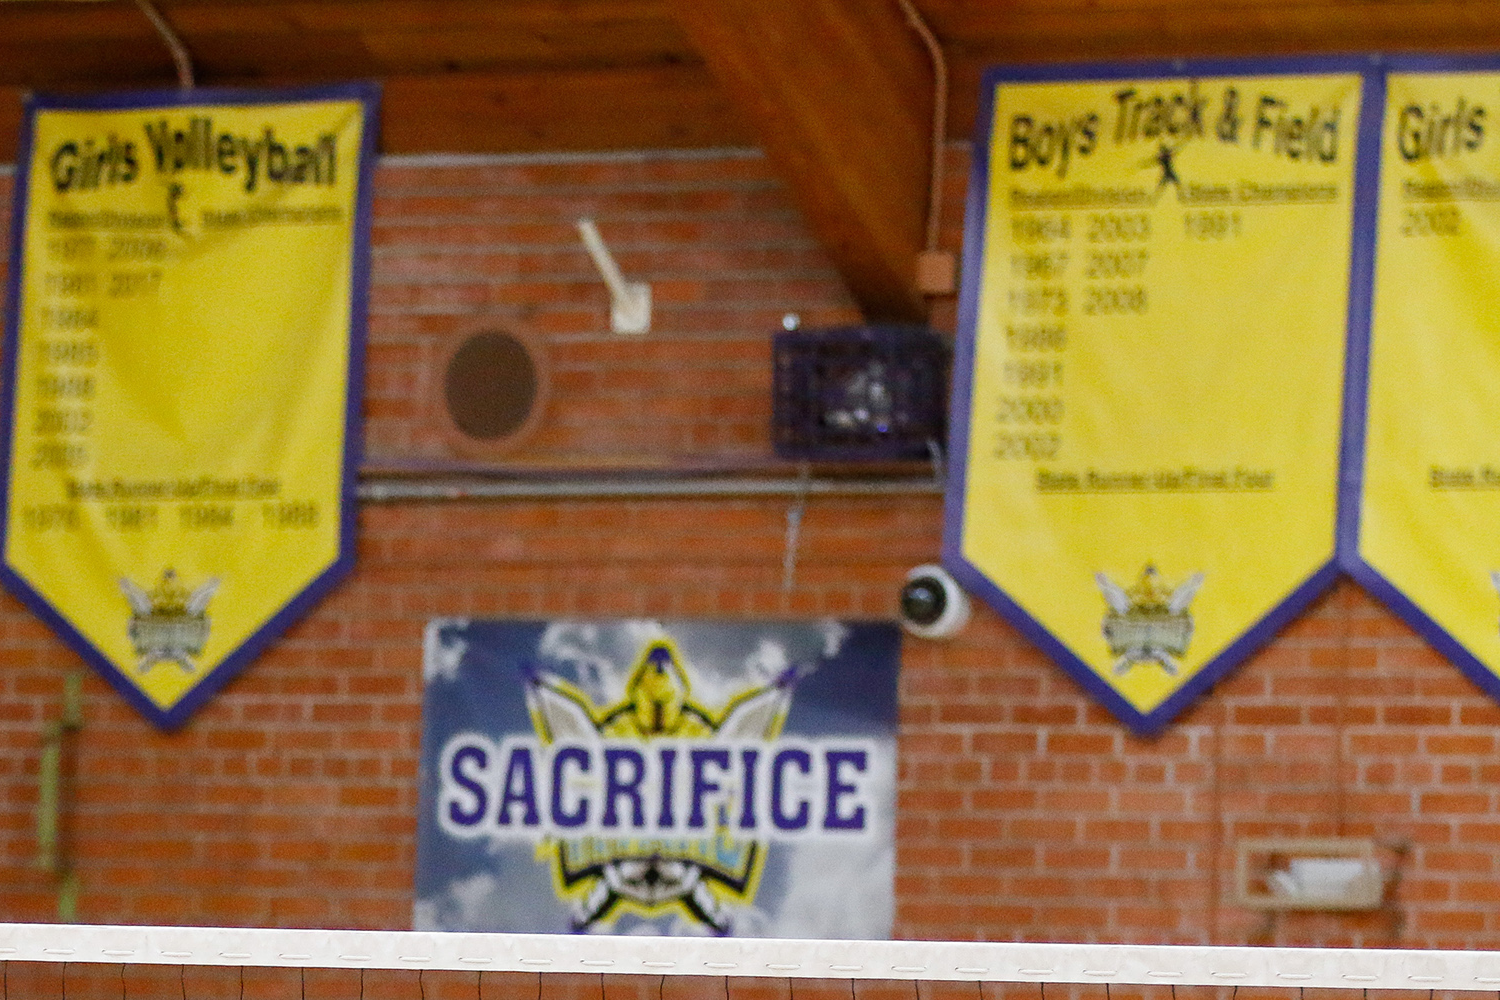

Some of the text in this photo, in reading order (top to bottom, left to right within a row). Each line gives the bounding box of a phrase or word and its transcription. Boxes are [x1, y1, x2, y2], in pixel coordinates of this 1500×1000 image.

[1008, 85, 1343, 180] Boys Track & Field
[1398, 97, 1486, 164] Girls
[51, 116, 338, 194] Girls Volleyball
[1087, 214, 1152, 241] 2003
[1183, 213, 1242, 238] 1991
[1086, 250, 1149, 277] 2007
[997, 395, 1063, 423] 2000
[448, 745, 868, 831] SACRIFICE
